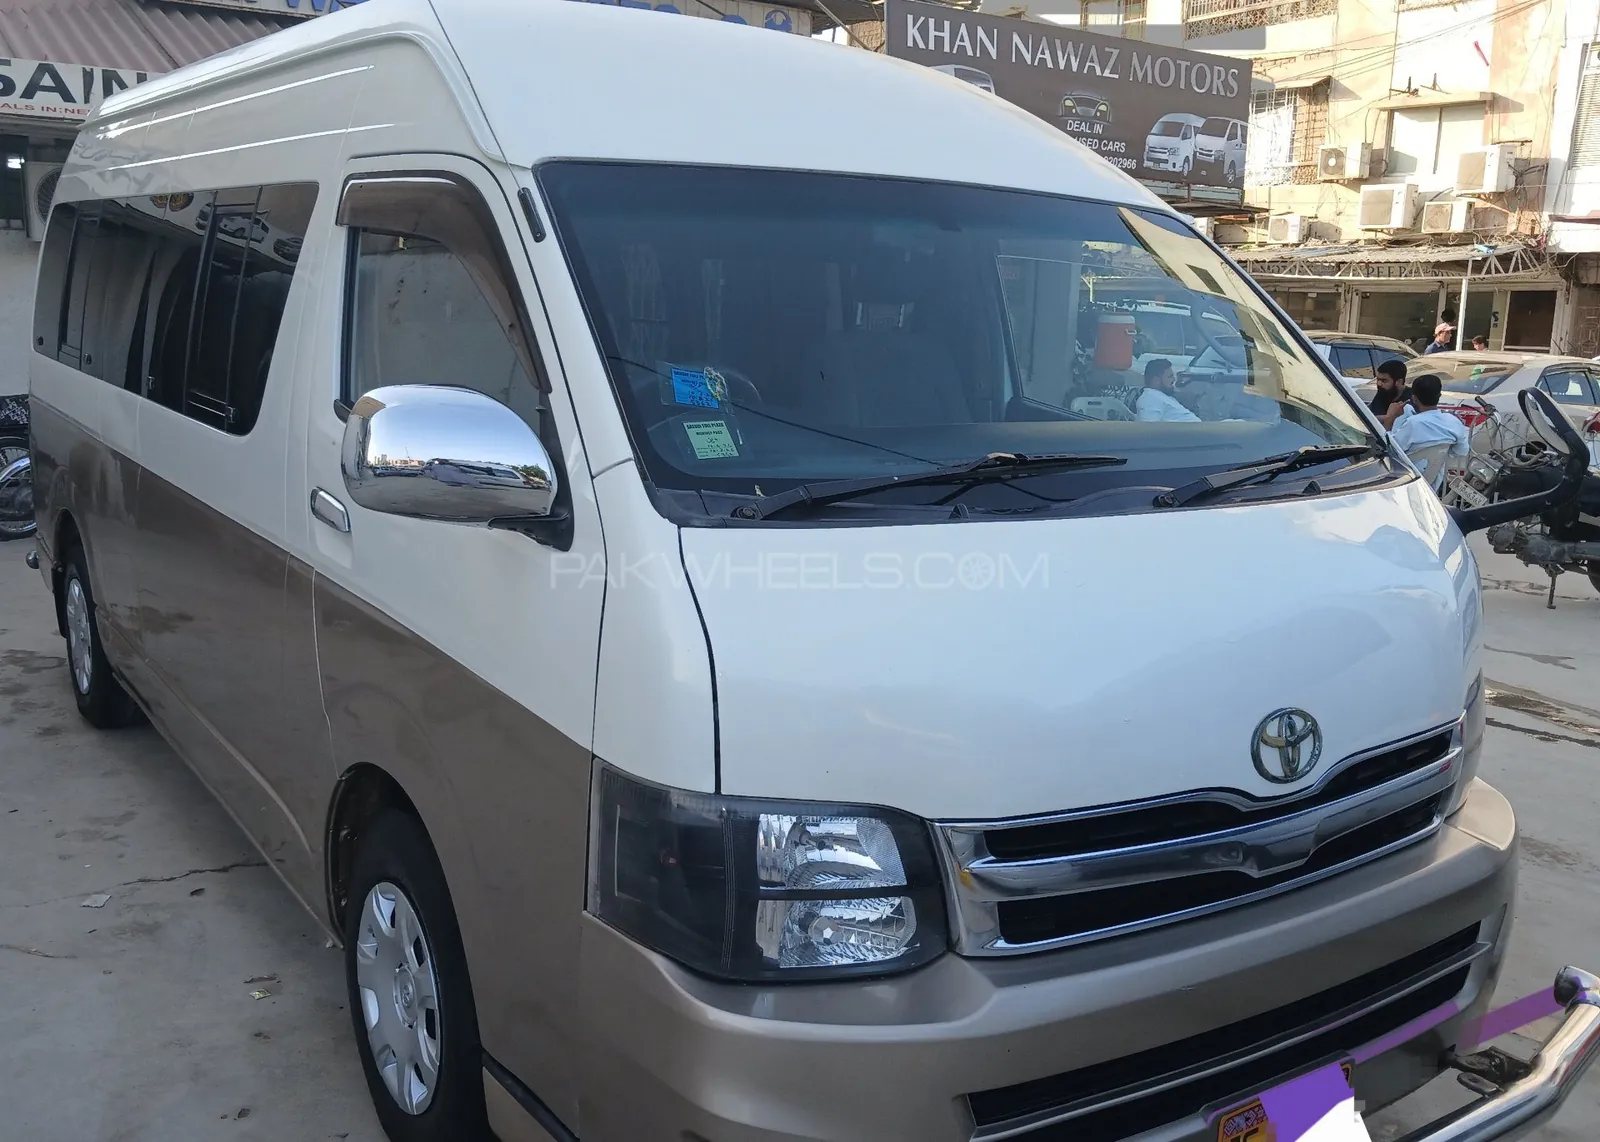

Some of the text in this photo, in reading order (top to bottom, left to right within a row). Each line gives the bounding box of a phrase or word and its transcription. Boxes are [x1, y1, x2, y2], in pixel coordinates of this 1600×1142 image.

[907, 14, 1238, 98] KHAN NAWAZ MOTORS
[41, 106, 90, 115] IN:NE
[1067, 120, 1104, 134] DEAL IN
[1101, 140, 1126, 153] CARS
